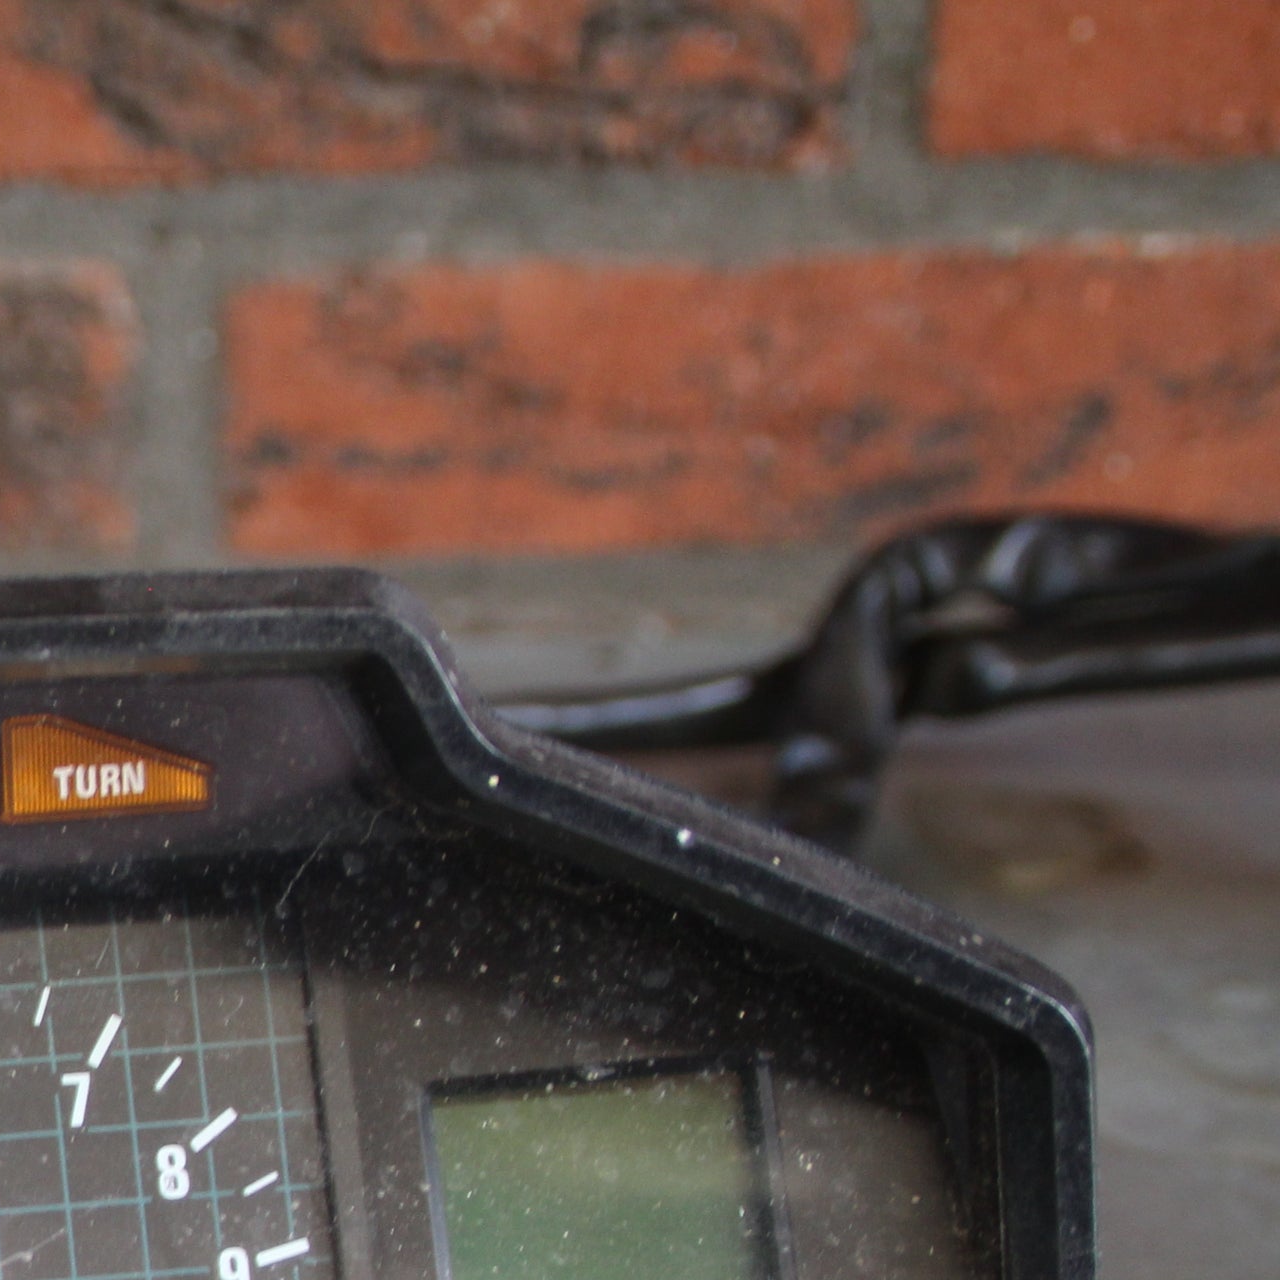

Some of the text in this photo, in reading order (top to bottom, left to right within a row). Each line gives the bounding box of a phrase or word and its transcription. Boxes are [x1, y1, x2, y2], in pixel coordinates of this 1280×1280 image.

[54, 762, 145, 798] TURN
[61, 1072, 90, 1127] 7
[156, 1144, 189, 1199] 8
